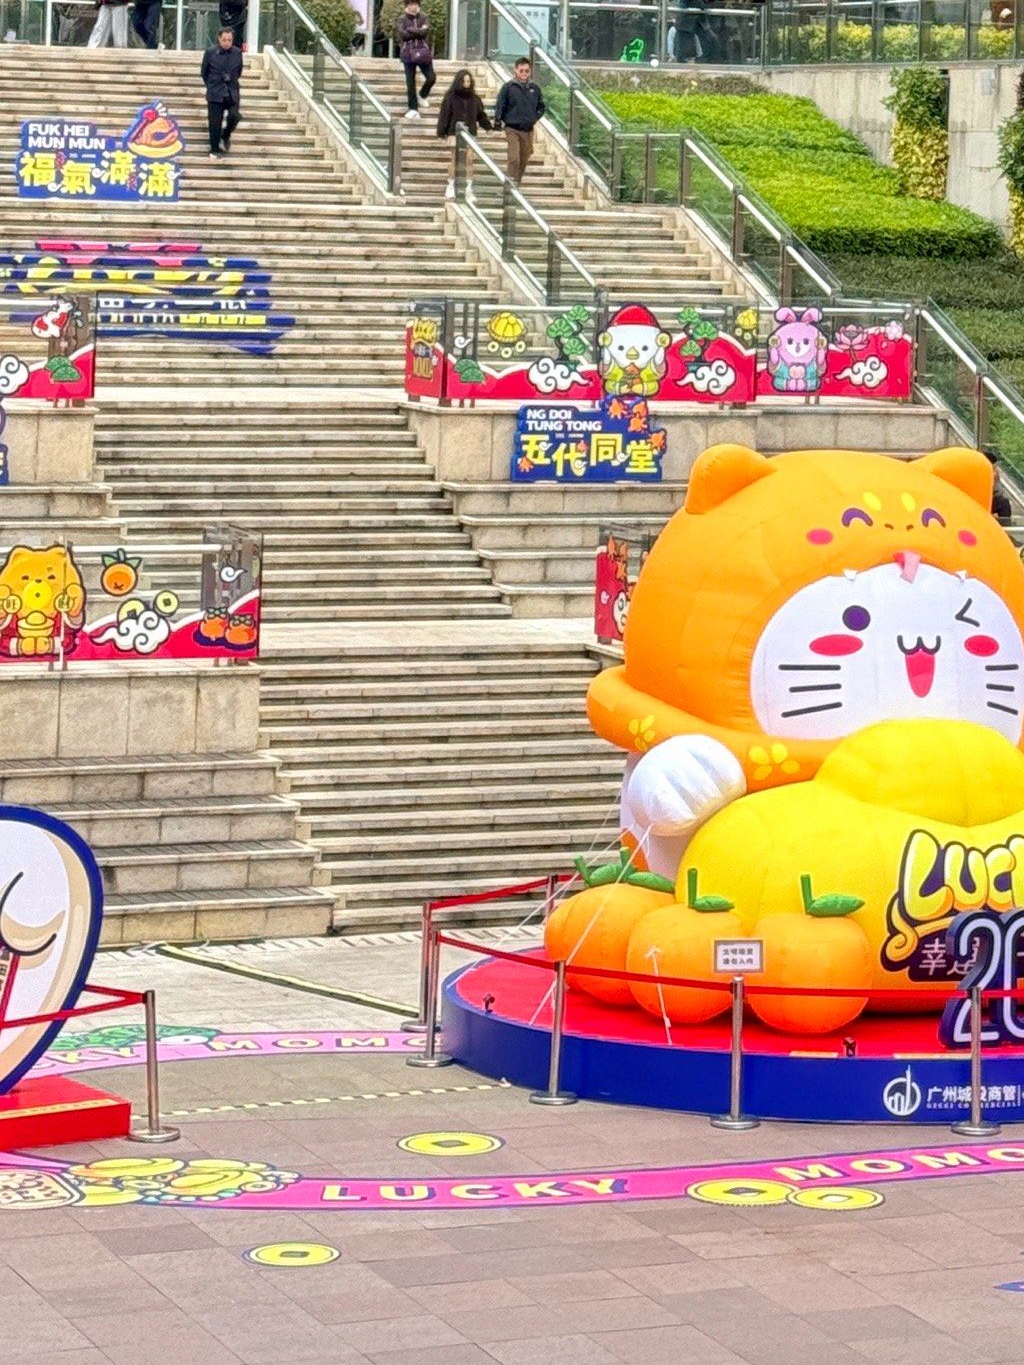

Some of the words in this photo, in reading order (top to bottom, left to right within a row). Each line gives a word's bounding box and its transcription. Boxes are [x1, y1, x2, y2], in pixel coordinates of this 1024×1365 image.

[28, 123, 61, 136] FUK
[63, 124, 90, 136] HEI
[28, 136, 64, 149] MUN
[69, 137, 106, 150] MUN
[526, 409, 546, 420] NG
[548, 409, 572, 420] DOI
[526, 420, 563, 431] TUNG
[566, 420, 602, 432] TONG
[517, 433, 658, 477] 五代同堂
[205, 1035, 442, 1052] MOMO
[321, 1178, 629, 1202] LUCKY
